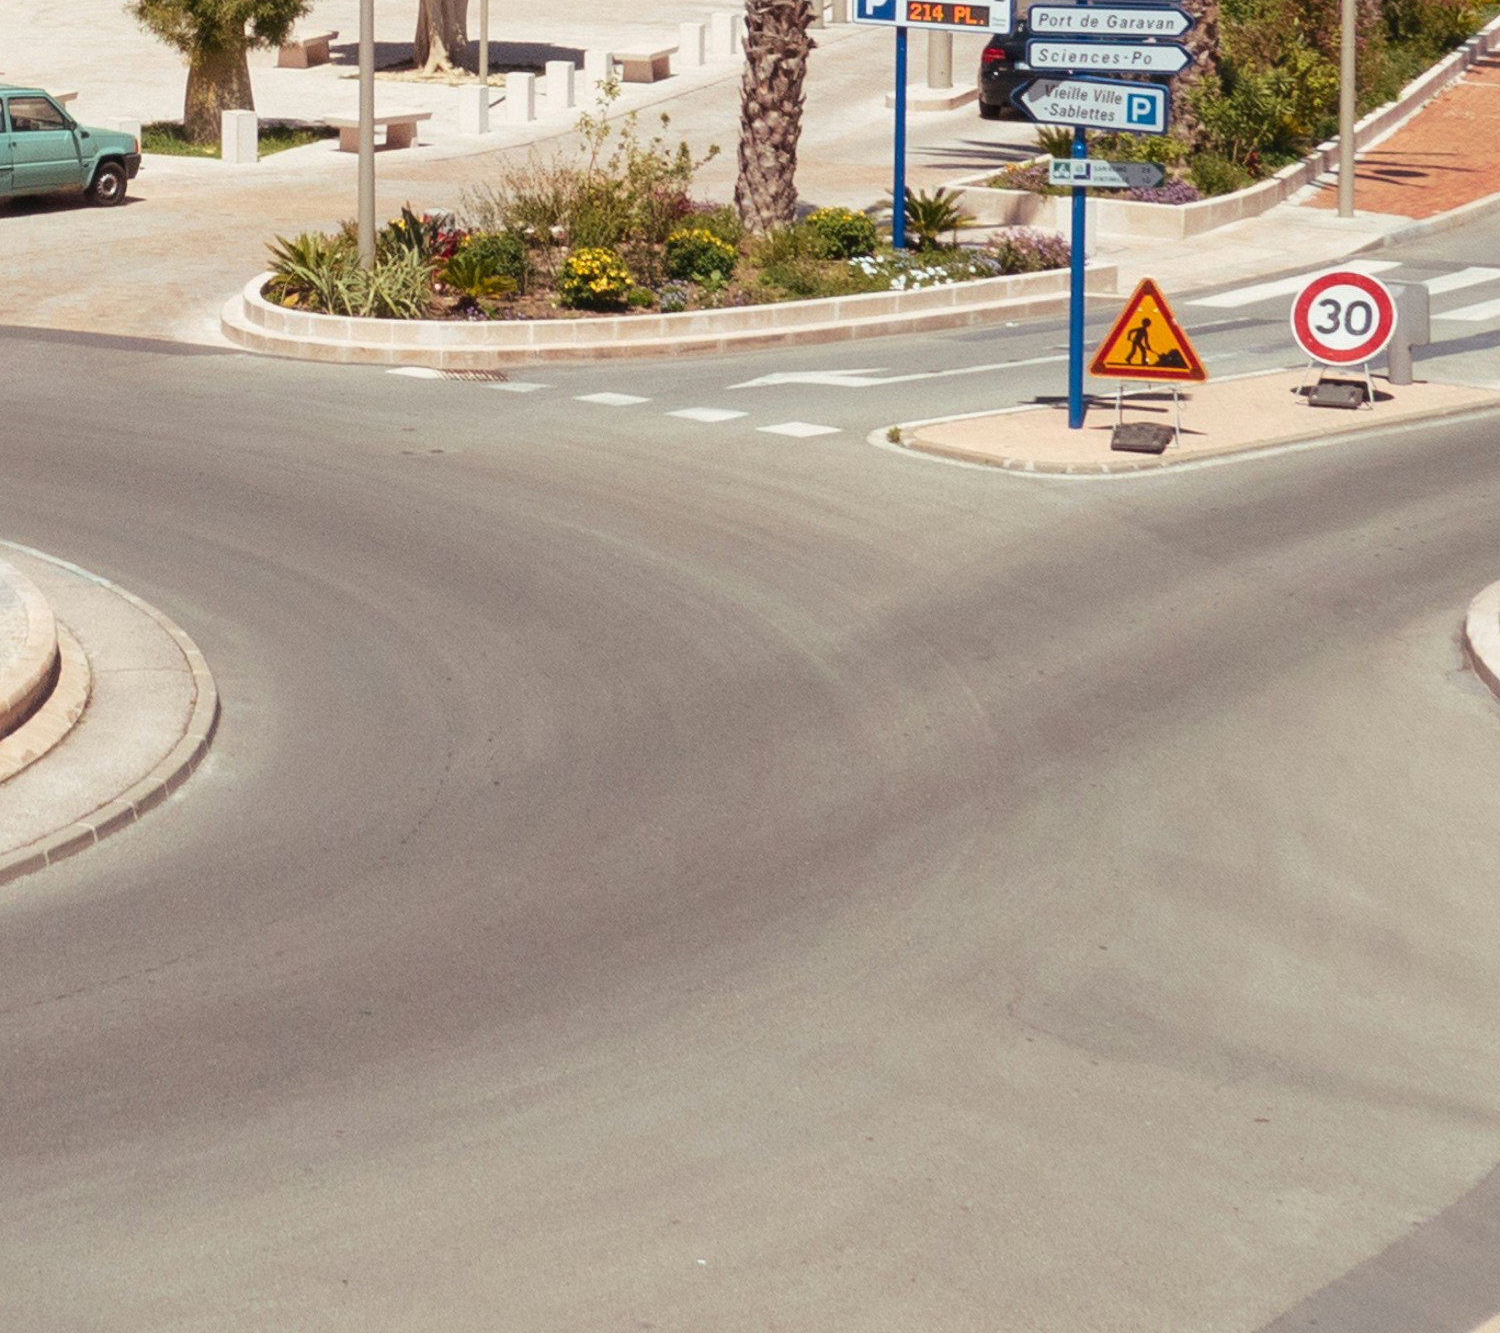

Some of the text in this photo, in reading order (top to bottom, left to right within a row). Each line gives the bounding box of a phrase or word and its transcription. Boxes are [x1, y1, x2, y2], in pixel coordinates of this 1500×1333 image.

[909, 2, 985, 25] 214 PL.
[1038, 12, 1175, 30] Port de Garavan
[1038, 48, 1152, 65] Sciences-Po
[1045, 84, 1123, 105] Vieille Ville
[1131, 96, 1151, 122] P
[1315, 298, 1373, 336] 30
